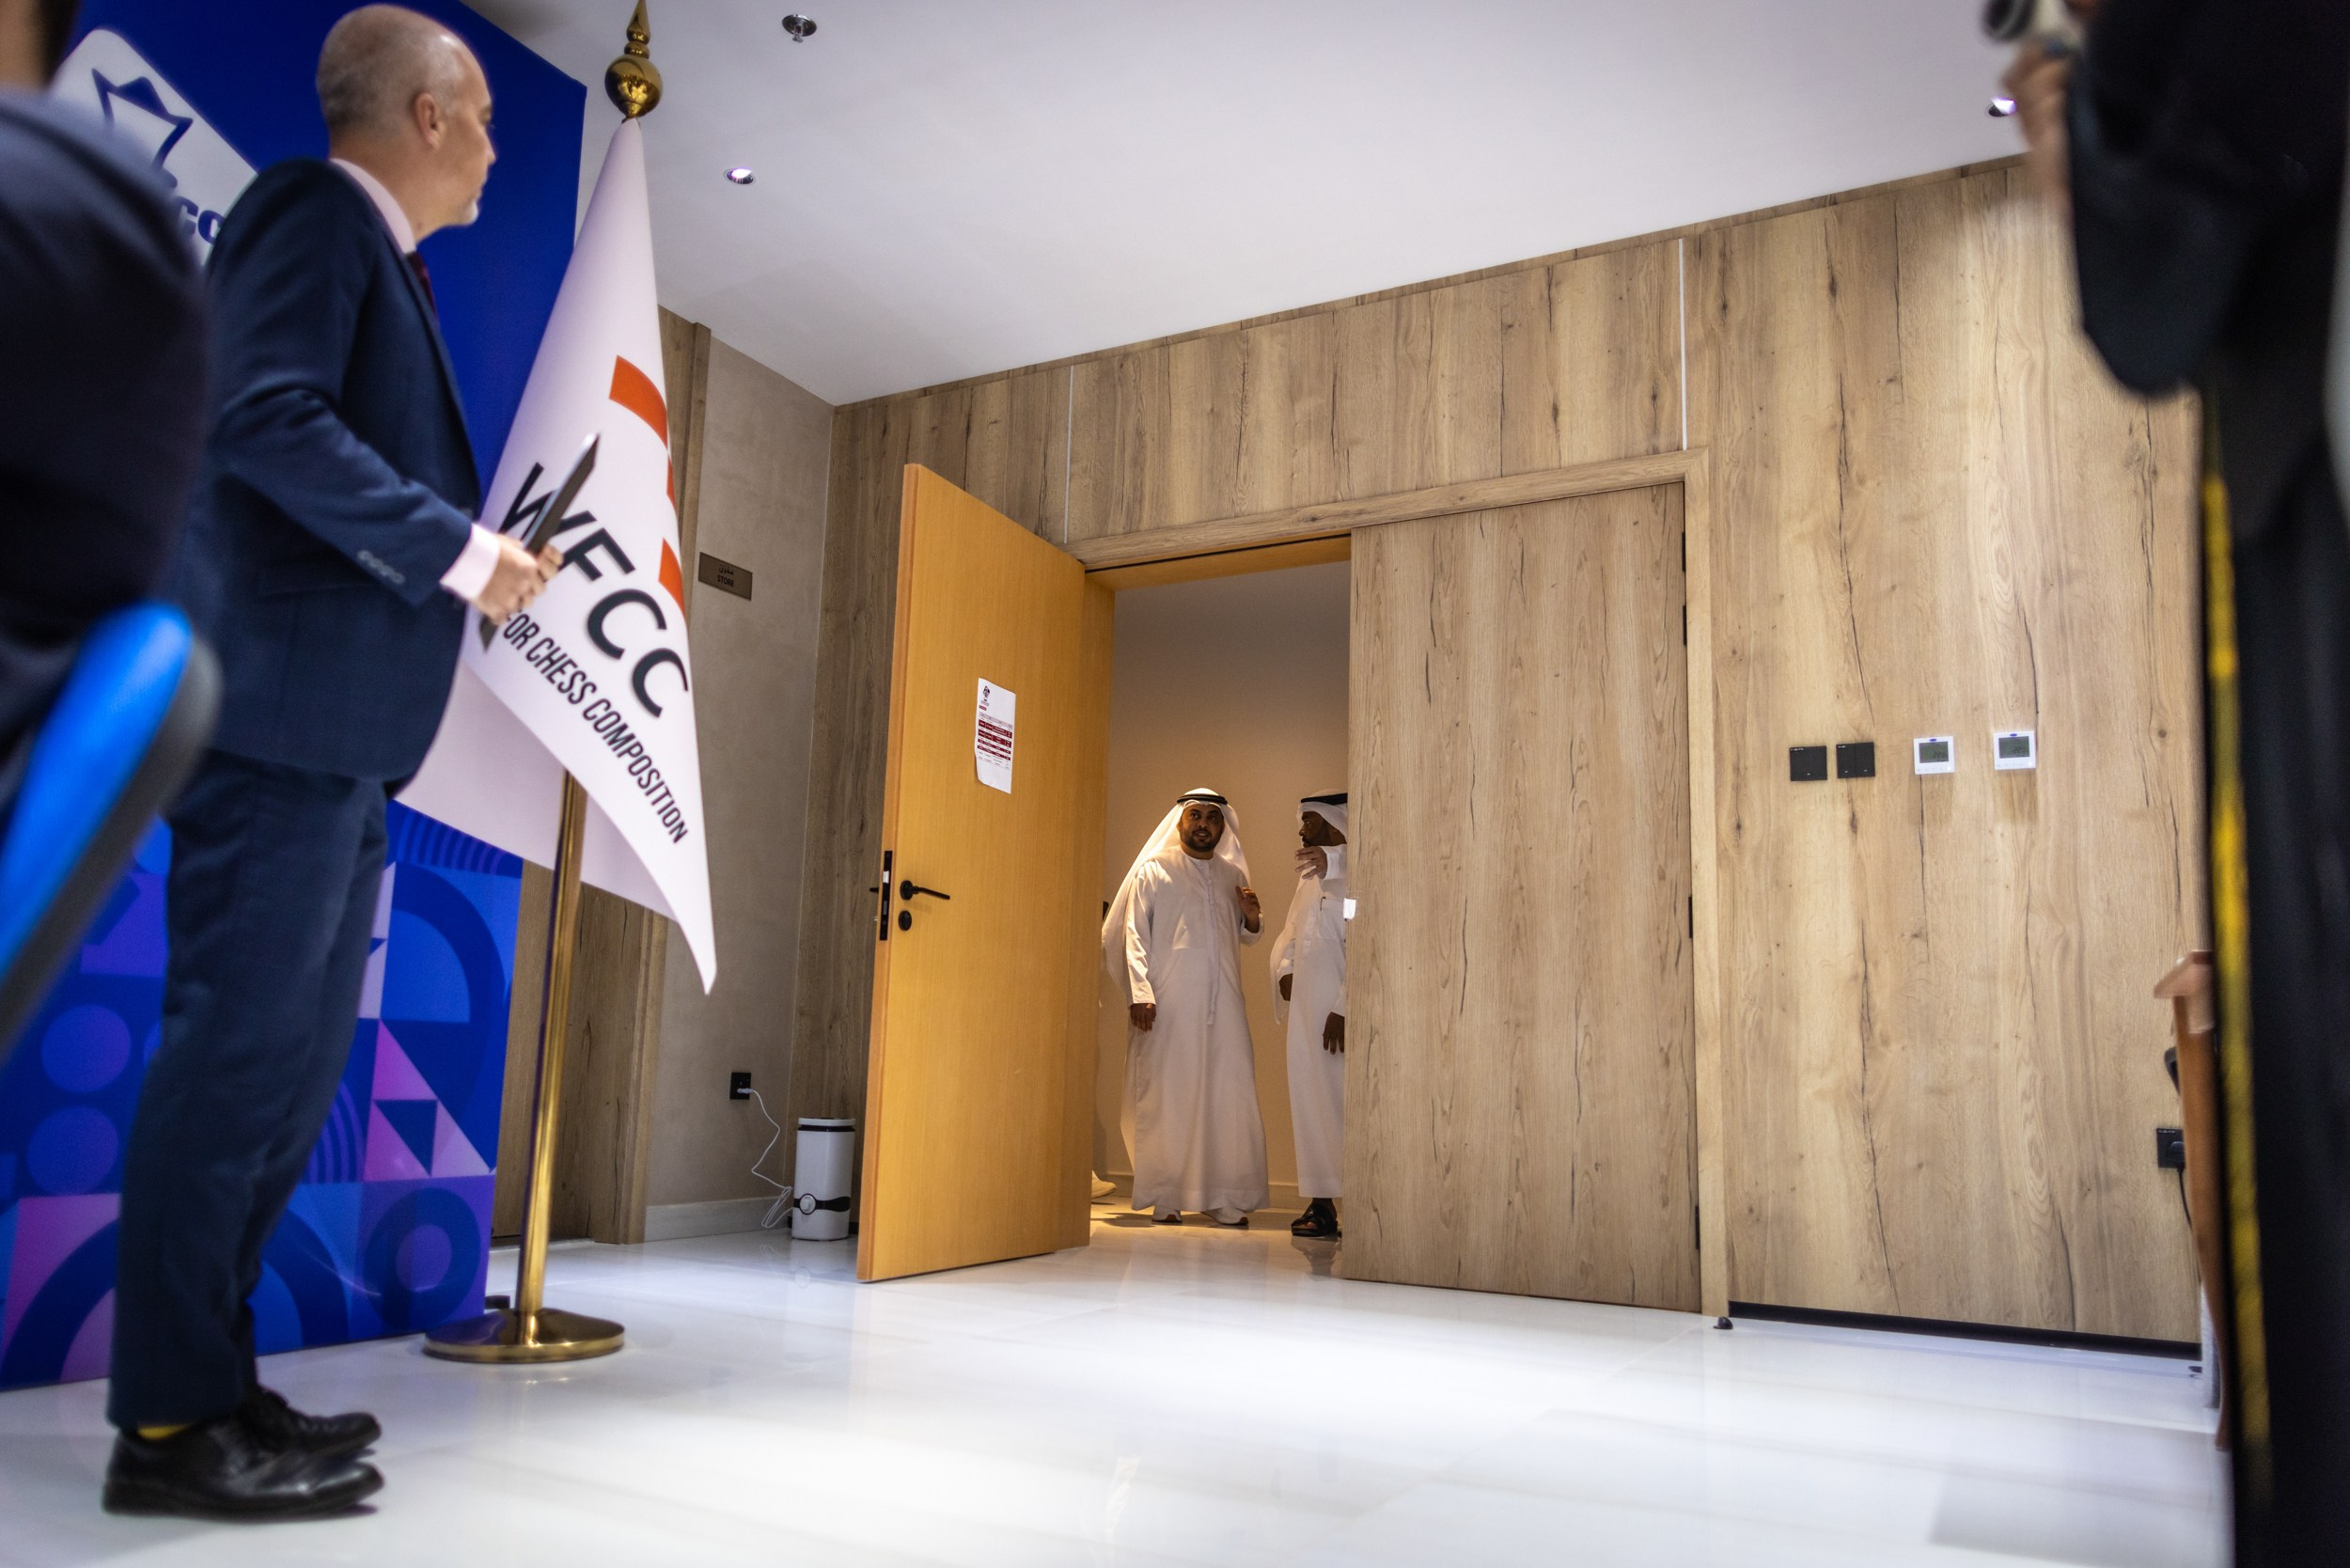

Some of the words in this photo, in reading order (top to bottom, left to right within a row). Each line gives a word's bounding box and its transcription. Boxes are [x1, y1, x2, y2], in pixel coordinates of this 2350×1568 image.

[498, 462, 688, 718] WFCC
[716, 574, 735, 588] STORE
[503, 611, 540, 651] OR
[525, 637, 597, 705] CHESS
[582, 698, 688, 844] COMPOSITION
